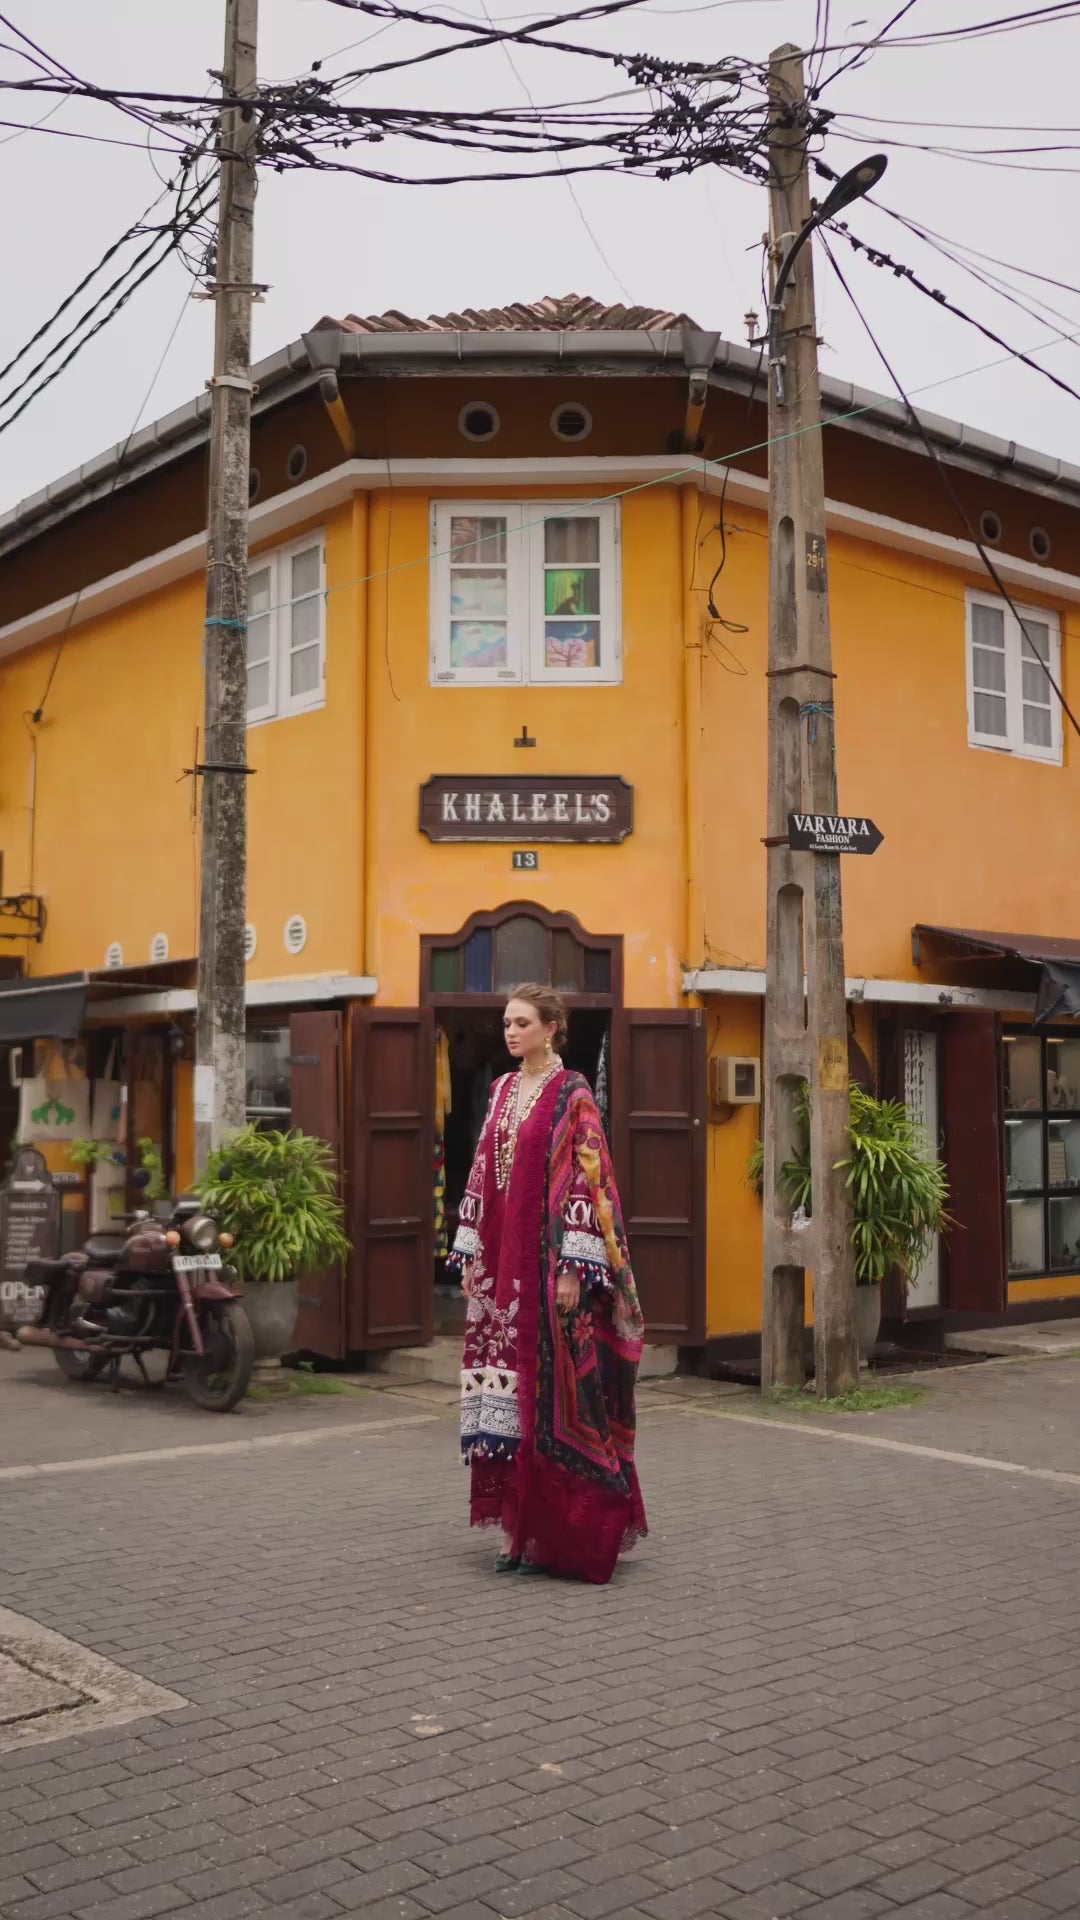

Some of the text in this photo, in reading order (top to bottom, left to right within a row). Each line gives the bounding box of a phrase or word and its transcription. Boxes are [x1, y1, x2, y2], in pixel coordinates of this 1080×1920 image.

[812, 539, 819, 553] F
[442, 792, 611, 823] KHALEEL'S
[793, 814, 870, 836] VARVARA
[515, 853, 536, 867] 13
